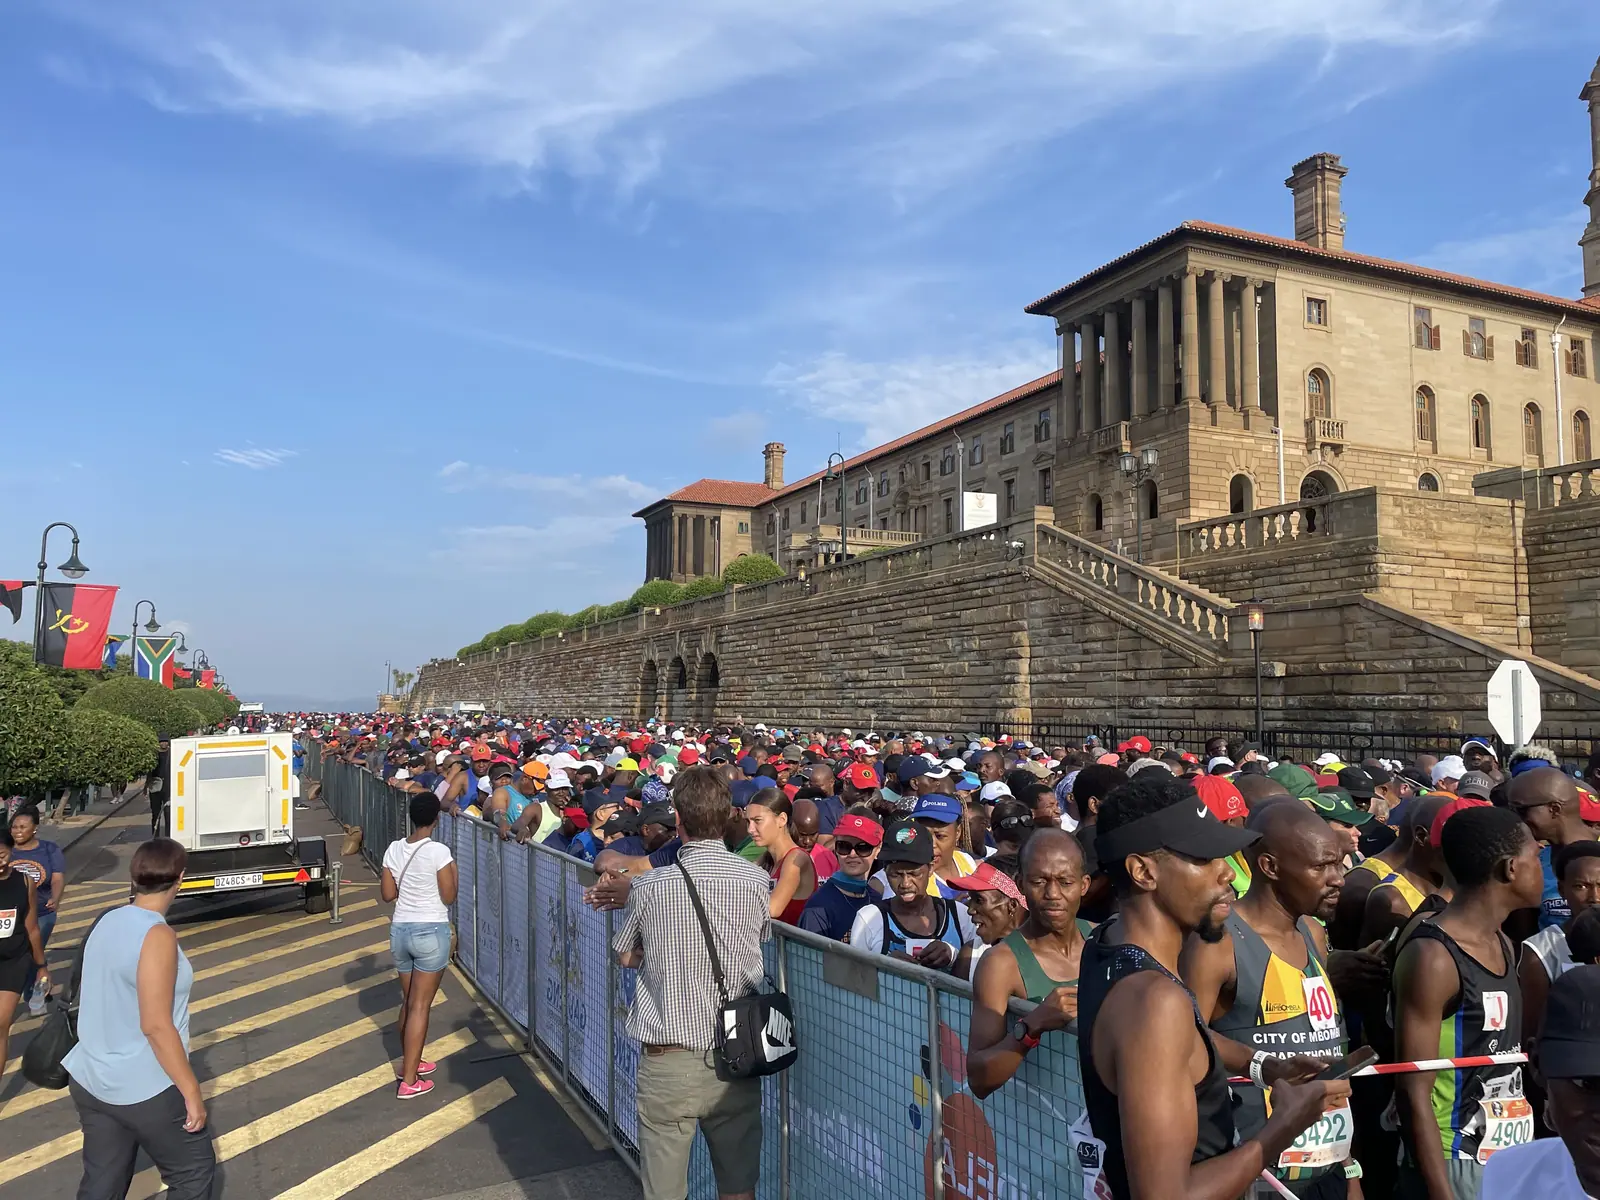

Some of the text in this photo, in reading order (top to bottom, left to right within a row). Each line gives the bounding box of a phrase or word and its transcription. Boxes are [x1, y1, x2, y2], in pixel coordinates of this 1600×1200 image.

[216, 875, 262, 887] DZ48CS GP
[1309, 985, 1333, 1022] 40
[1490, 996, 1503, 1027] J
[767, 1006, 792, 1047] NIKE
[1252, 1033, 1287, 1044] CITY
[1291, 1032, 1307, 1044] OF
[1491, 1119, 1530, 1146] 4900
[1078, 1144, 1098, 1158] ASA
